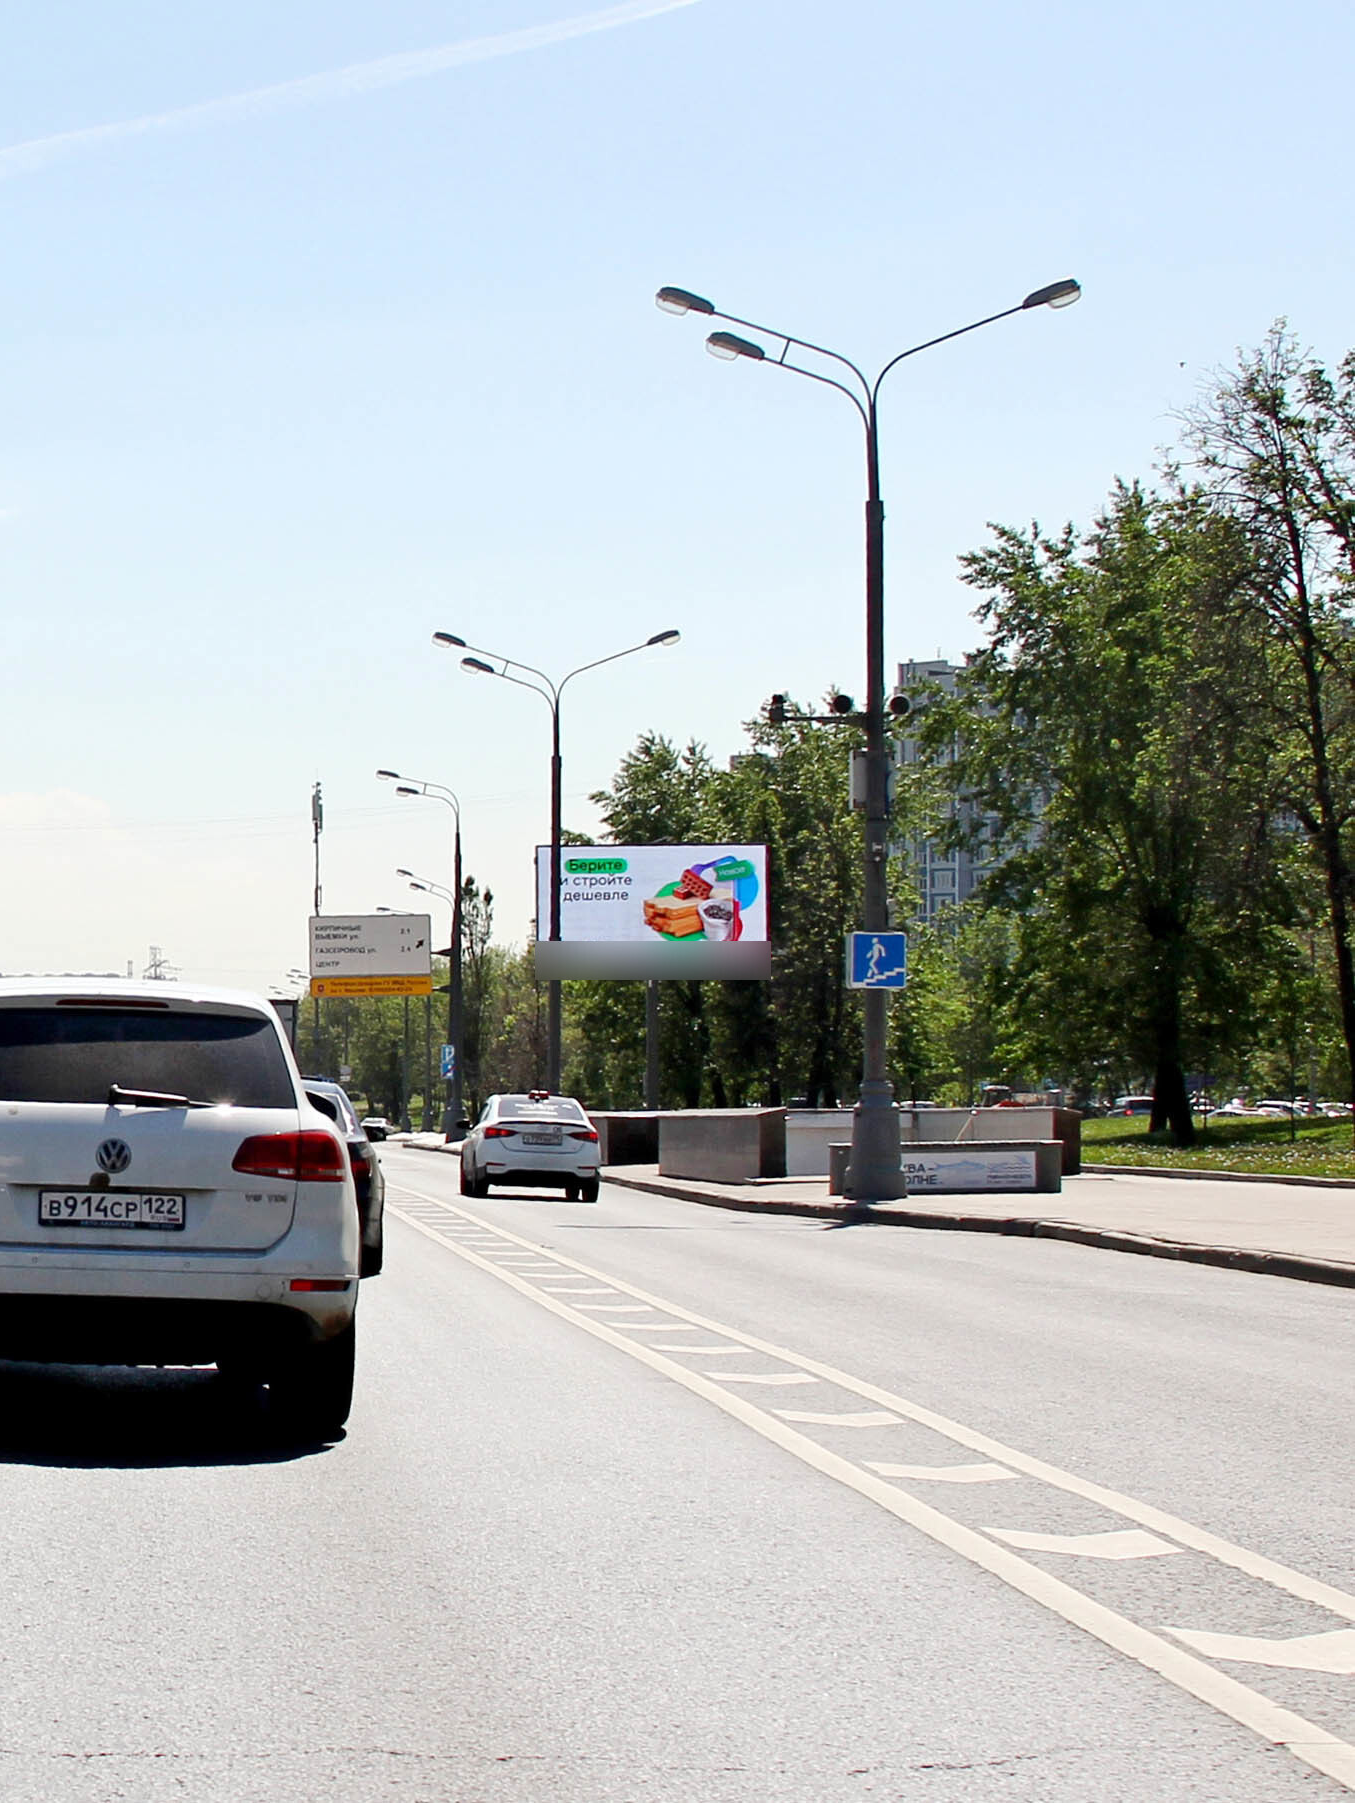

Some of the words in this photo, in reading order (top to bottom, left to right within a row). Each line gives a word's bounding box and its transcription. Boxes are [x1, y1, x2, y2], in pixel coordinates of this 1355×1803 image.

[569, 859, 623, 874] Берите
[573, 873, 632, 888] стройте
[563, 890, 629, 902] дешевле
